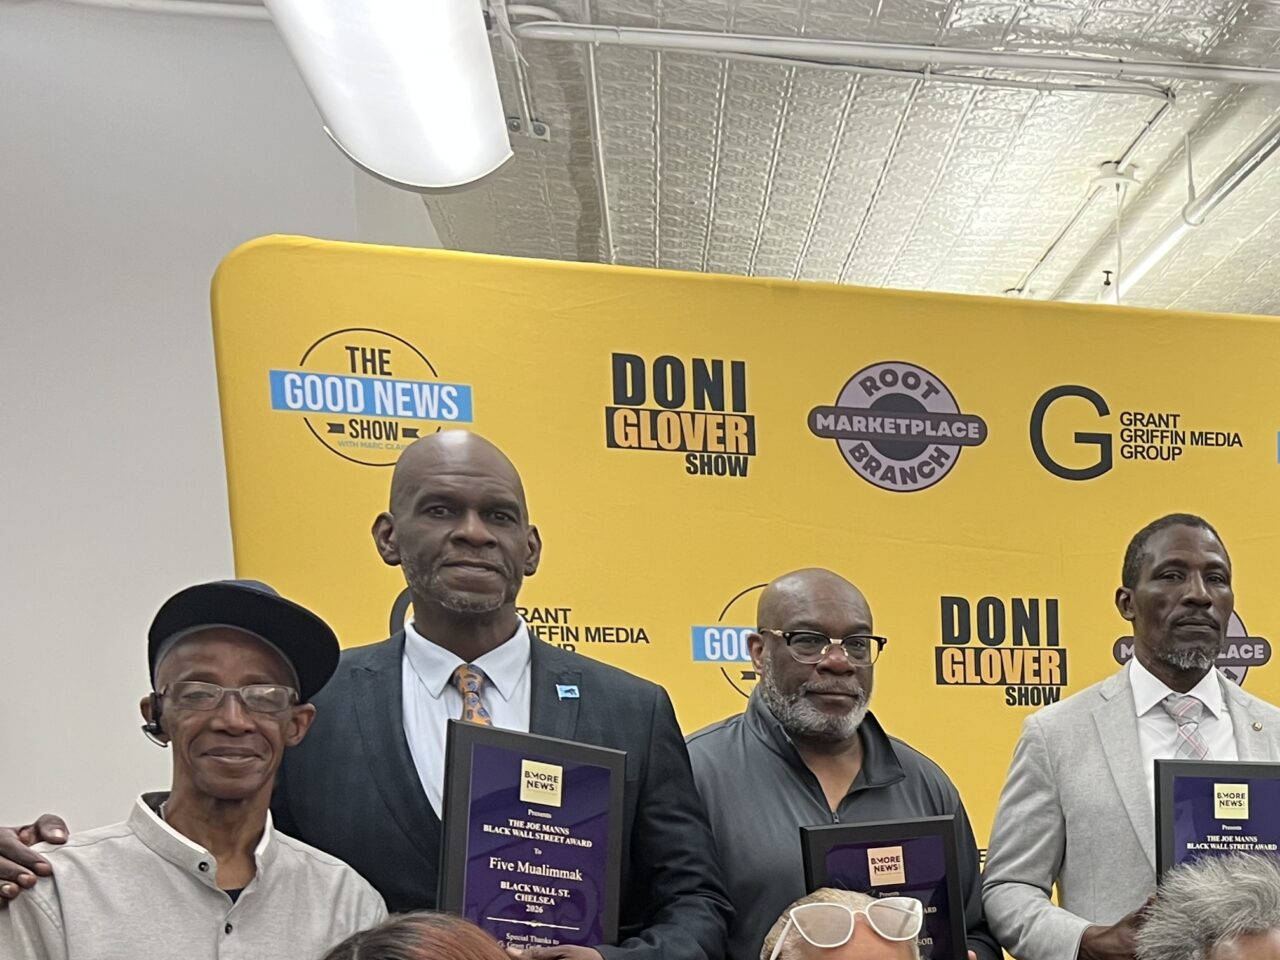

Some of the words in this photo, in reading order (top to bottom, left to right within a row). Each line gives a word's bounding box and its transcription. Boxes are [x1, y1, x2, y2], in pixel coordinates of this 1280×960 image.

[345, 346, 392, 376] THE
[612, 353, 746, 412] DONI
[859, 368, 940, 400] ROOT
[284, 373, 365, 413] GOOD
[373, 381, 459, 420] NEWS
[349, 419, 398, 441] SHOW
[613, 409, 748, 453] GLOVER
[816, 414, 979, 438] MARKETPLACE
[1120, 411, 1180, 428] GRANT
[1030, 385, 1113, 481] G
[1120, 429, 1185, 445] GRIFFIN
[1190, 431, 1243, 447] MEDIA
[686, 453, 748, 477] SHOW
[849, 442, 950, 485] BRANCH
[1120, 445, 1182, 461] GROUP
[520, 607, 571, 624] RANT
[941, 596, 1059, 646] DONI
[585, 627, 650, 644] MEDIA
[704, 628, 754, 660] GOO
[942, 648, 1061, 684] GLOVER
[1005, 687, 1060, 706] SHOW
[483, 825, 512, 835] BLACK
[512, 830, 533, 839] WALL
[536, 833, 564, 844] STREET
[565, 837, 592, 848] AWARD
[508, 819, 525, 829] THE
[526, 822, 541, 831] JOE
[542, 825, 569, 835] MANNS
[489, 857, 514, 871] Five
[518, 861, 583, 881] Mualimmak
[500, 881, 531, 892] BLACK
[532, 885, 557, 896] WALL
[559, 889, 570, 898] ST.
[515, 893, 555, 905] CHELSEA
[526, 905, 544, 913] 2026
